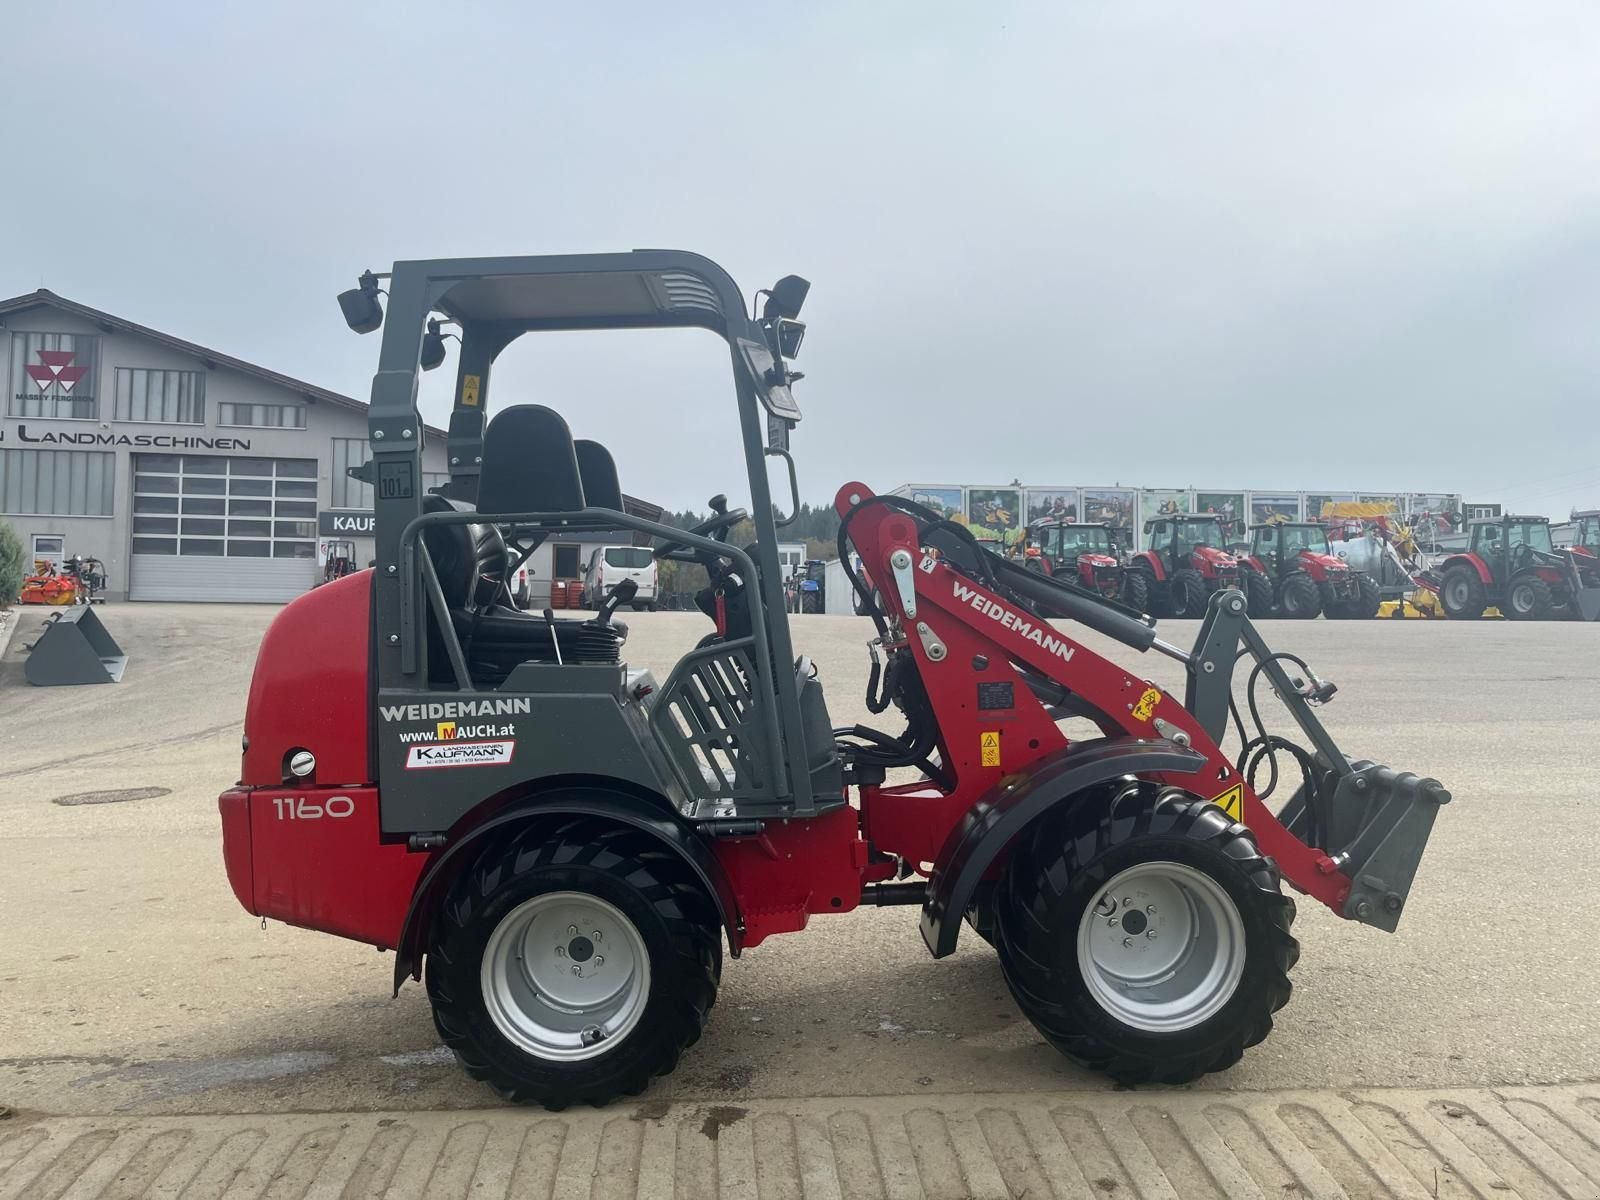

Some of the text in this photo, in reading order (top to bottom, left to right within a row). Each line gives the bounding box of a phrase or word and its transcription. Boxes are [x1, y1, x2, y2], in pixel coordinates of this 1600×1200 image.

[16, 393, 95, 402] MASSEY FERGUSON
[18, 424, 251, 450] LANDMASCHINEN
[383, 478, 401, 497] 101
[953, 581, 1075, 662] WEIDEMANN
[379, 697, 531, 722] WEIDEMANN
[399, 722, 515, 743] www.MAUCH.at
[416, 748, 504, 760] KAUFMANN
[443, 744, 504, 752] LANDMASCHINEN
[272, 795, 355, 820] 1160
